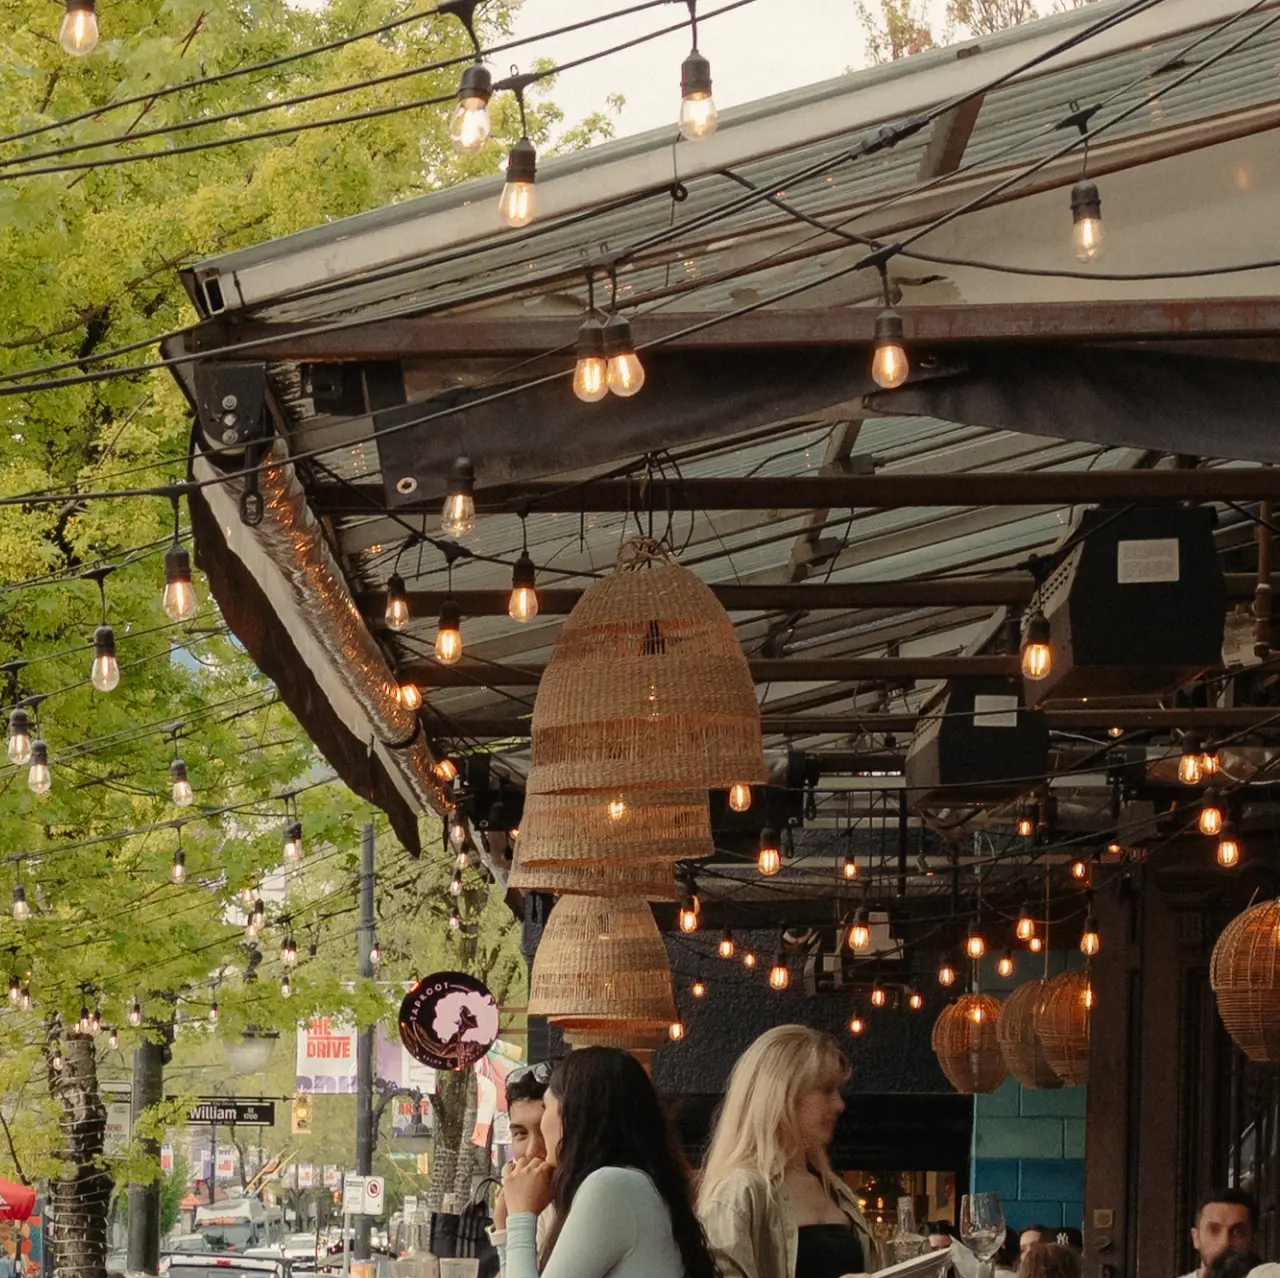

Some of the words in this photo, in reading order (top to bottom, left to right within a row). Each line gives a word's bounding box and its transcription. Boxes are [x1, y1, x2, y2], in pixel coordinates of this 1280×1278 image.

[409, 982, 449, 1021] TAPROOT
[306, 1041, 352, 1059] DRIVE
[190, 1105, 237, 1120] William
[243, 1113, 259, 1121] 1700
